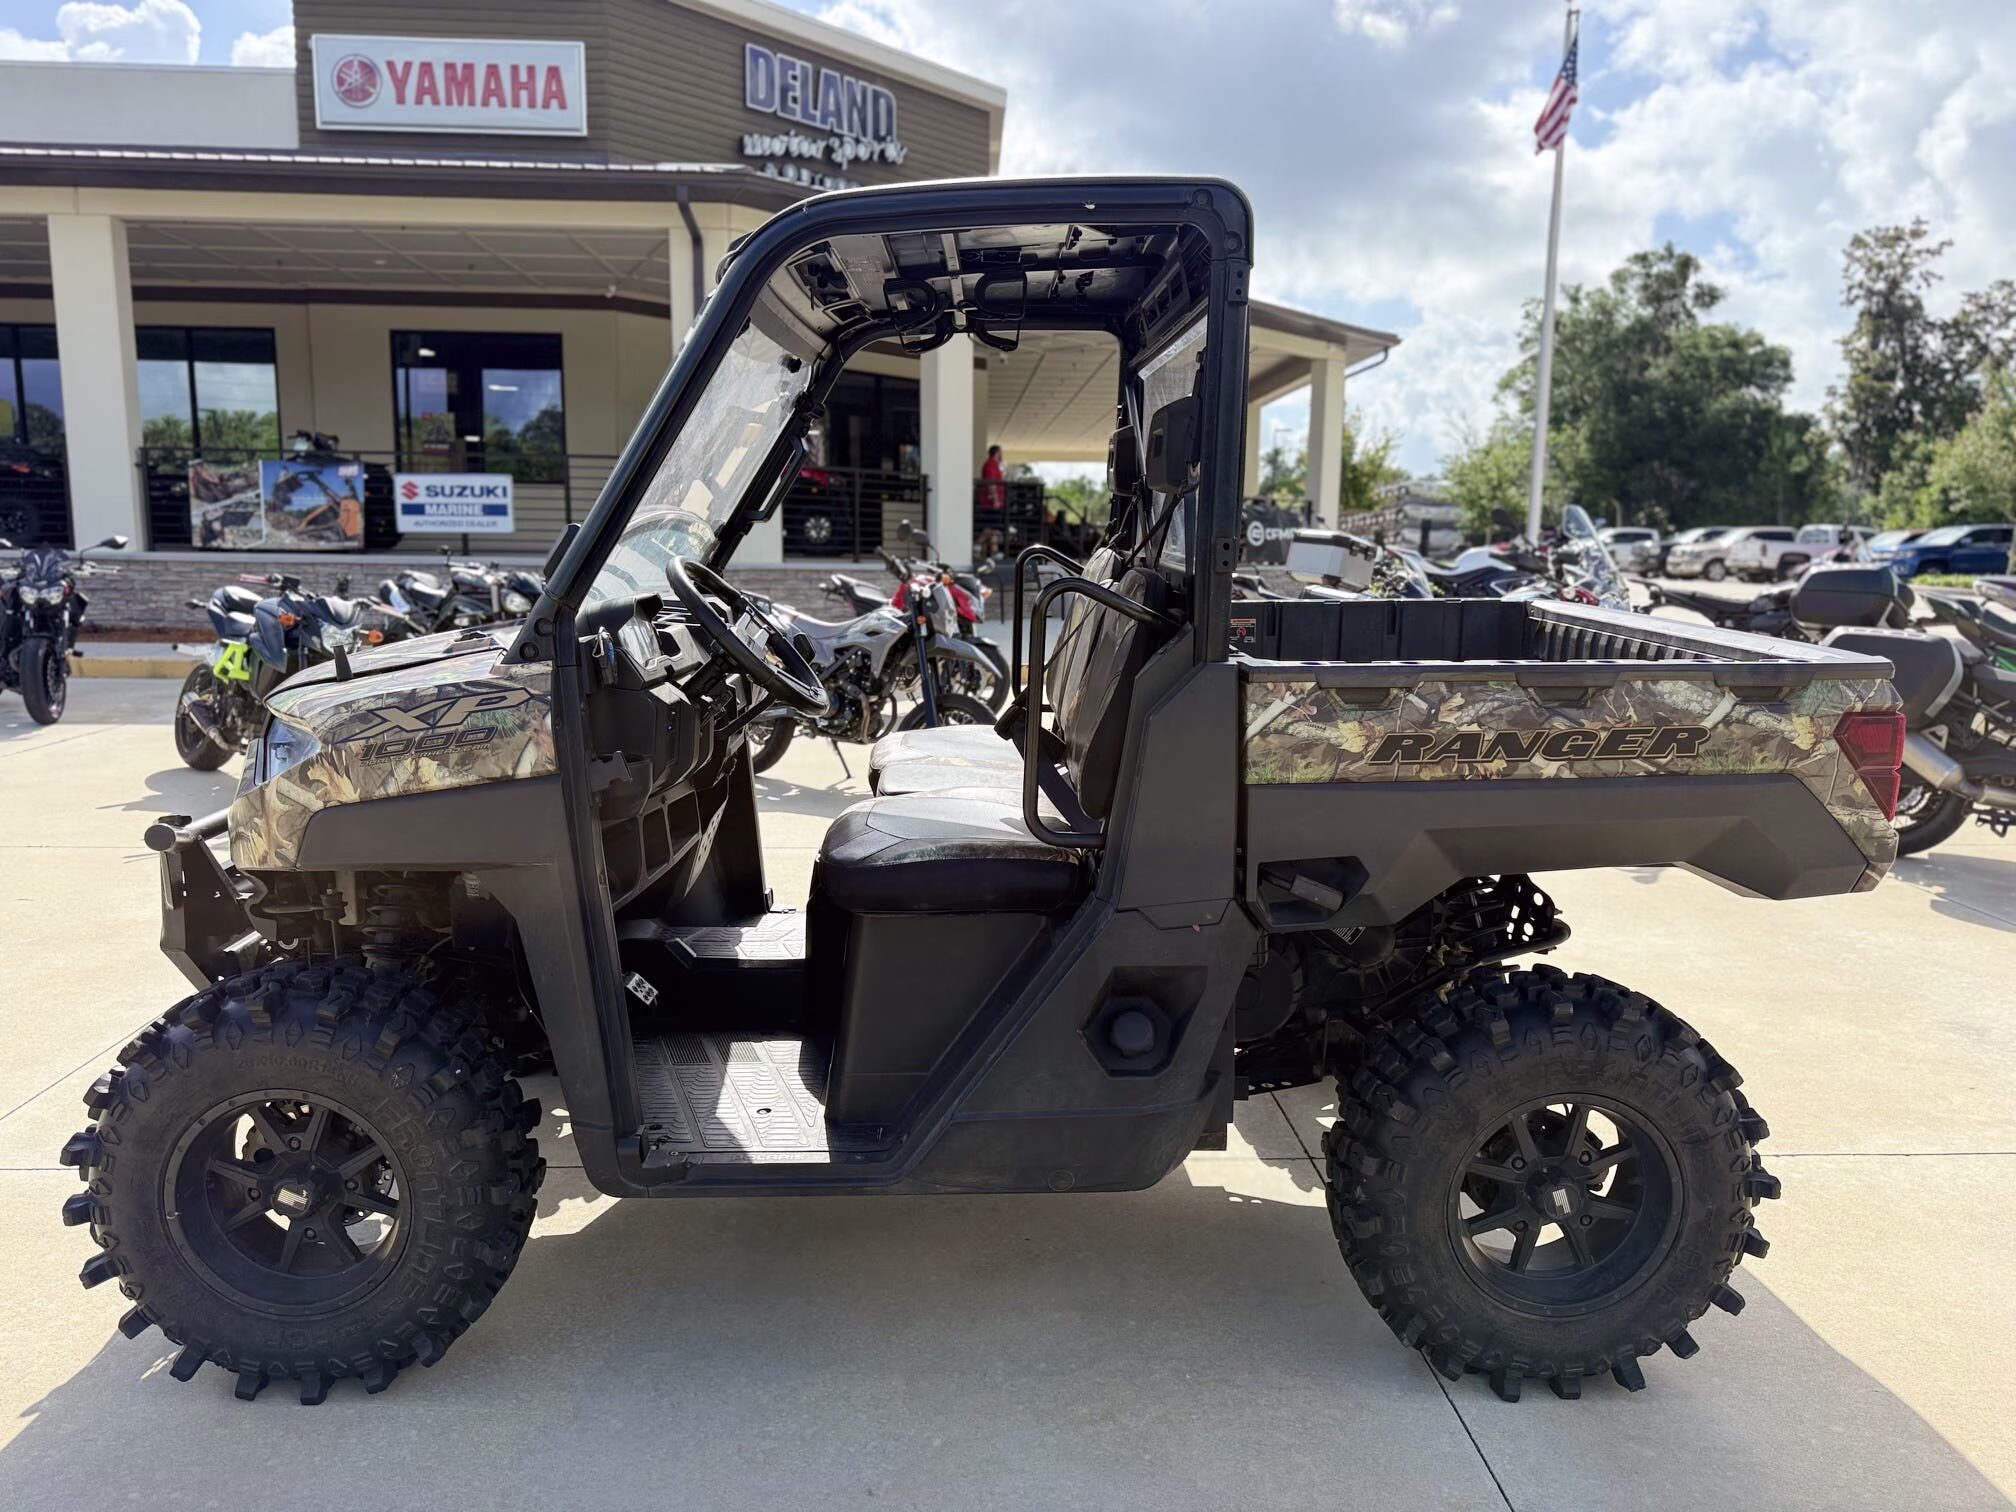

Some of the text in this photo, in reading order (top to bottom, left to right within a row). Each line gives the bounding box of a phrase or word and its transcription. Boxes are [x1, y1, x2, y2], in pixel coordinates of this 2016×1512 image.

[385, 60, 568, 110] YAMAHA
[745, 42, 897, 143] DELAND
[425, 484, 507, 498] SUZUKI
[424, 504, 482, 516] MARINE
[466, 520, 498, 529] DEALER
[335, 687, 533, 744] XP
[360, 726, 498, 761] 1000
[1368, 725, 1711, 764] RANGER
[733, 1153, 806, 1162] POLARIS
